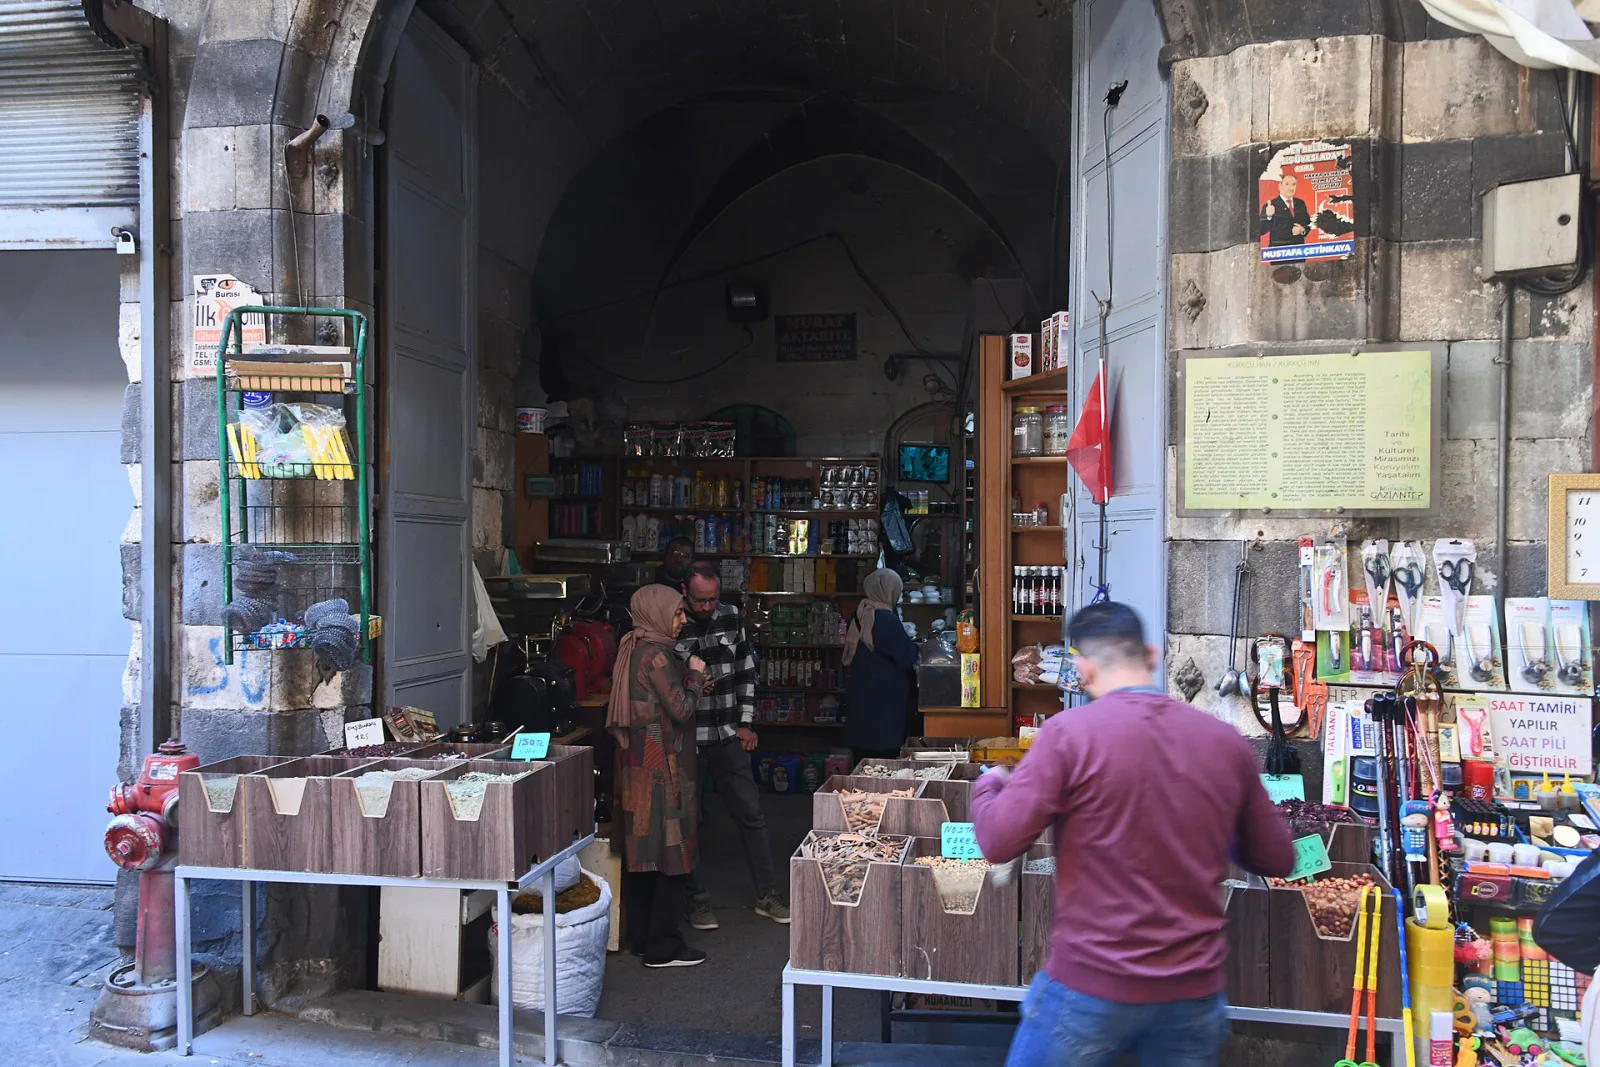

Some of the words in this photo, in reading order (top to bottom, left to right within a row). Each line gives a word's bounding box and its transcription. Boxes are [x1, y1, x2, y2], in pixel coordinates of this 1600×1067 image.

[1262, 248, 1302, 259] MUSTAFA
[1304, 243, 1351, 256] ÇETİNKAYA
[196, 301, 216, 326] ilk
[1373, 464, 1420, 472] Koruyalım
[1376, 472, 1421, 480] Yaşatalım
[1579, 497, 1591, 505] 11
[1574, 517, 1586, 526] 10
[1575, 549, 1582, 558] 8
[1581, 568, 1588, 576] 7
[1491, 700, 1525, 712] SAAT
[1529, 701, 1576, 714] TAMİRİ
[1509, 718, 1558, 731] YAPILIR
[1501, 736, 1537, 748] SAAT
[1542, 736, 1566, 750] PİLİ
[1508, 753, 1577, 769] ĞİŞTİRİLİR
